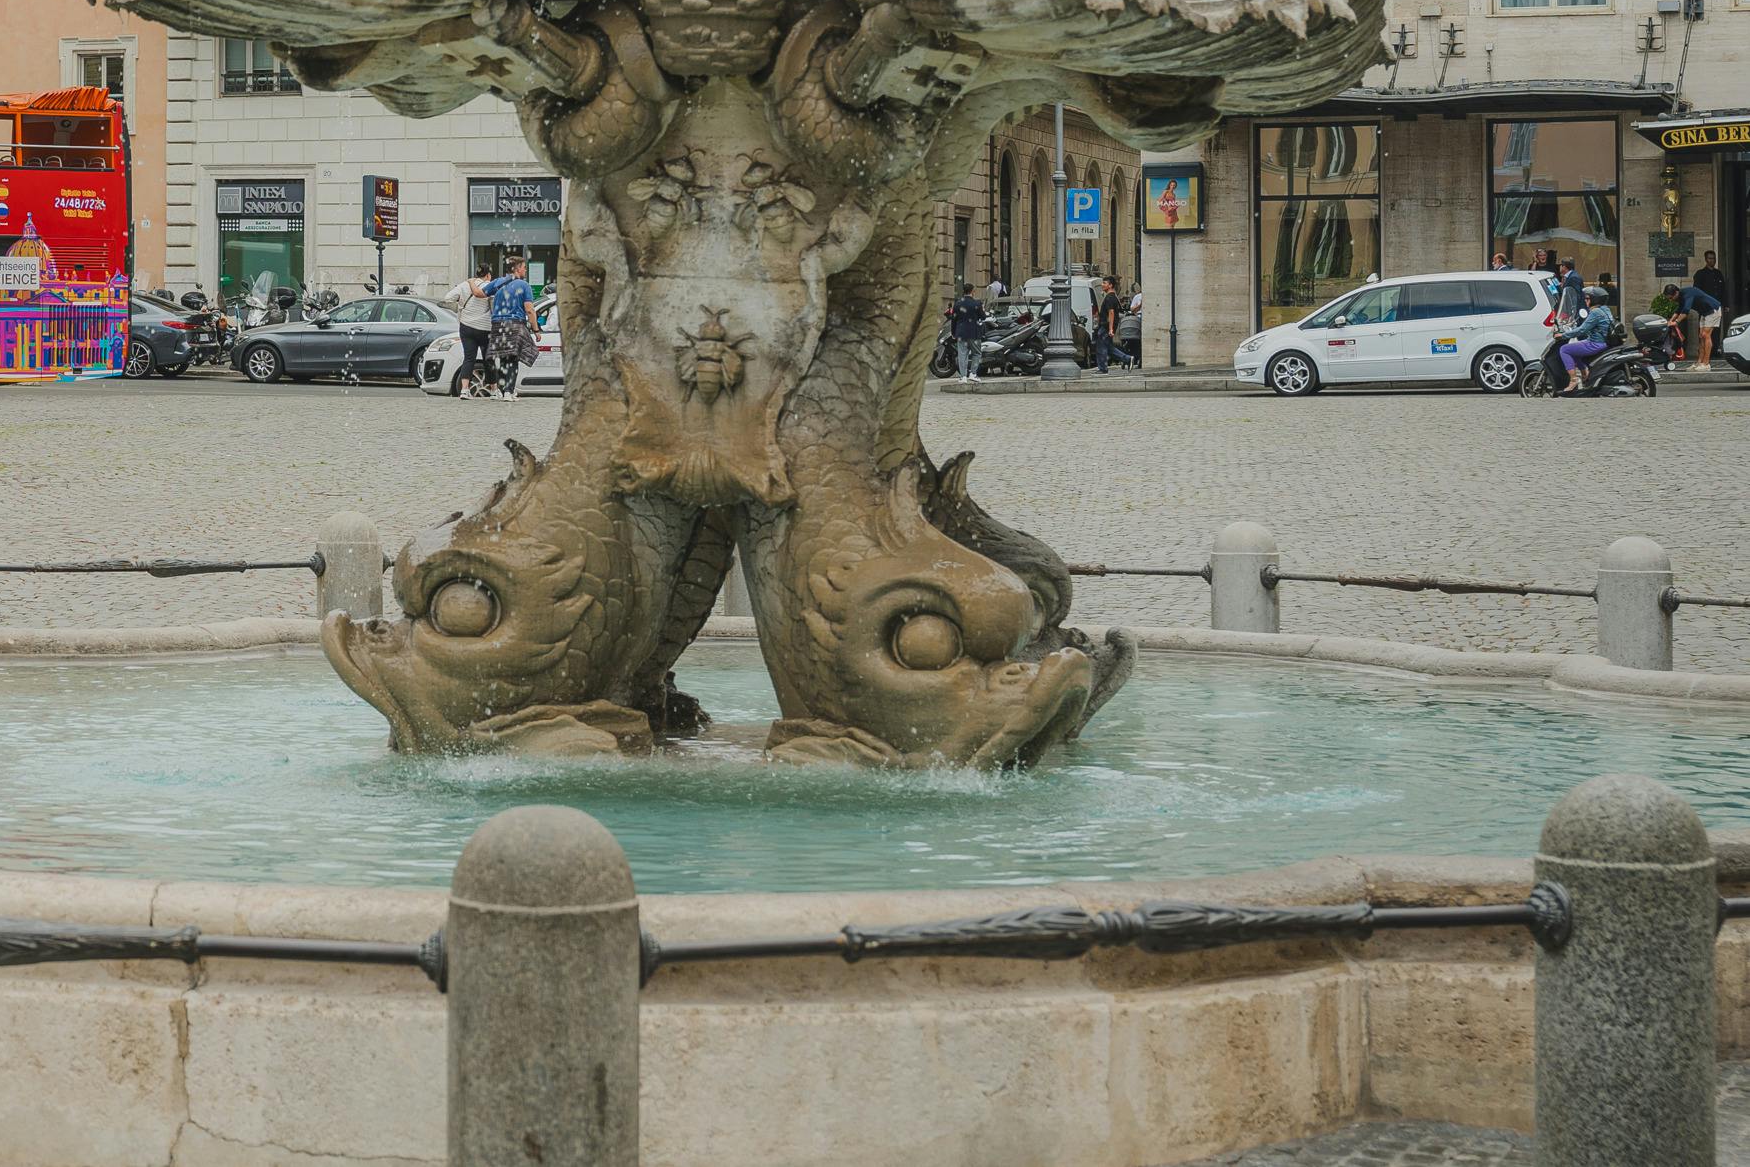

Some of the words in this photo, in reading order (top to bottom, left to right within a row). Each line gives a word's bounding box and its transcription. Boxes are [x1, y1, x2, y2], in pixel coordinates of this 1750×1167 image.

[1670, 128, 1708, 146] SINA
[245, 186, 287, 199] INTESA
[498, 185, 542, 198] INTESA
[244, 201, 304, 214] SANPAOLO
[498, 199, 561, 213] SANPAOLO
[1073, 192, 1093, 219] P
[1080, 226, 1094, 234] fila
